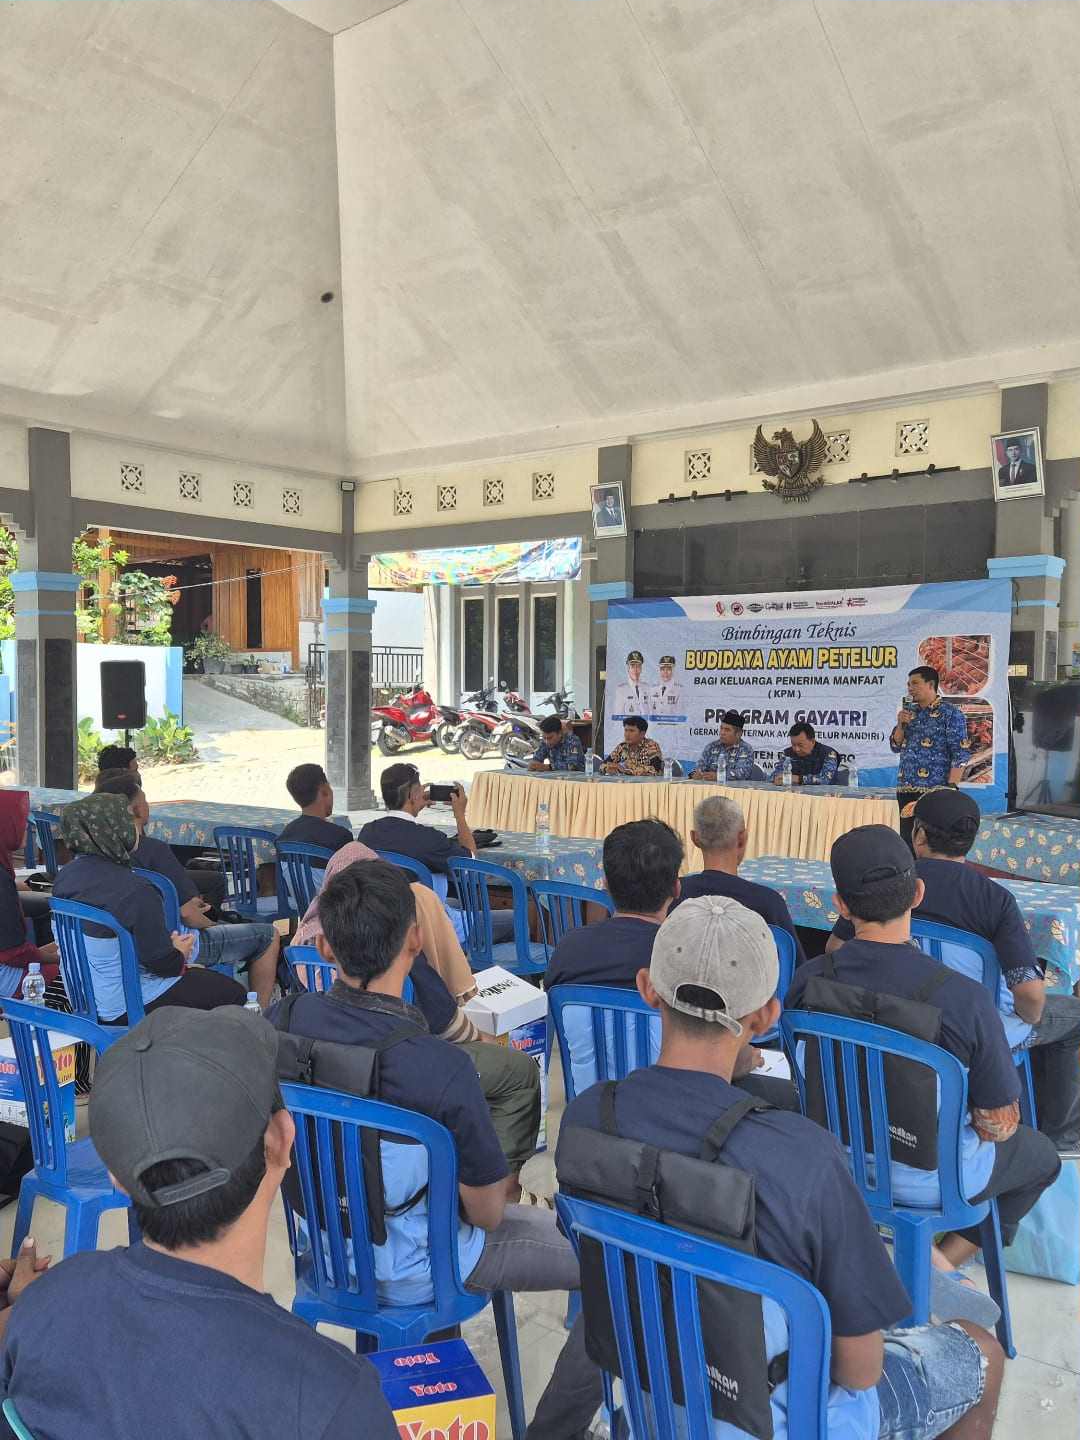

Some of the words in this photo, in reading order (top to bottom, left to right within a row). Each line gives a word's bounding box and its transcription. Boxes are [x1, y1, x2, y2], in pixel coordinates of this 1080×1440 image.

[722, 624, 801, 644] Bimbingan
[807, 621, 857, 642] Teknis
[685, 649, 765, 671] BUDIDAYA
[767, 647, 814, 670] AYAM
[817, 646, 898, 669] PETELUR
[694, 676, 717, 685] BAGI
[720, 676, 773, 686] KELUARGA
[776, 676, 830, 686] PENERIMA
[833, 675, 885, 685] MANFAAT
[704, 709, 789, 725] PRGRAM
[743, 729, 775, 738] TERNAK
[815, 731, 840, 740] TELUR
[409, 1382, 458, 1397] Yoto
